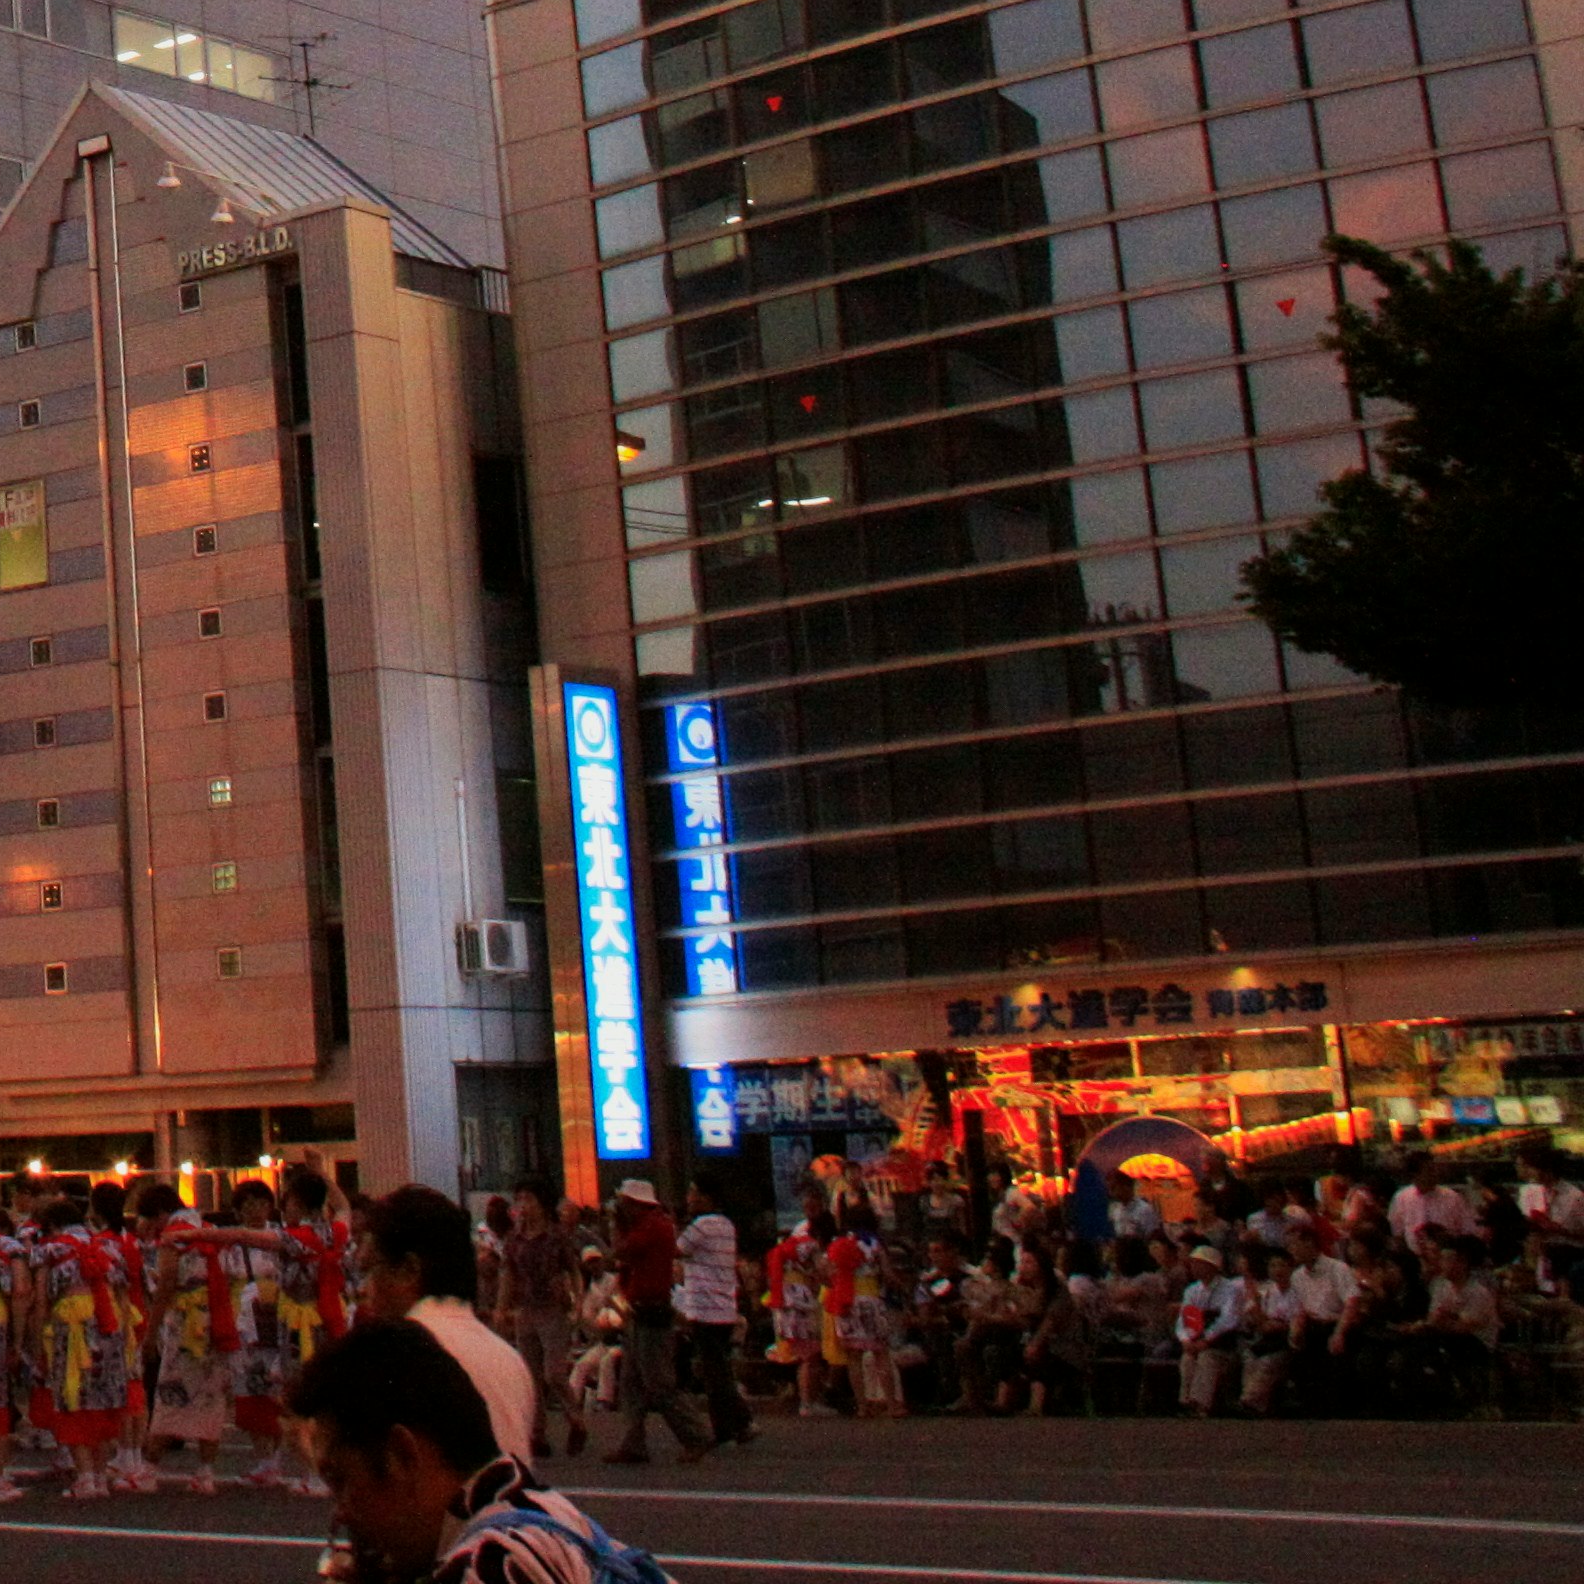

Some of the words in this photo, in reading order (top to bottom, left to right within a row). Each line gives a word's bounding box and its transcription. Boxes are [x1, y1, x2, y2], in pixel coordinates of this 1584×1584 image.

[577, 765, 644, 1151] 東北大進学会
